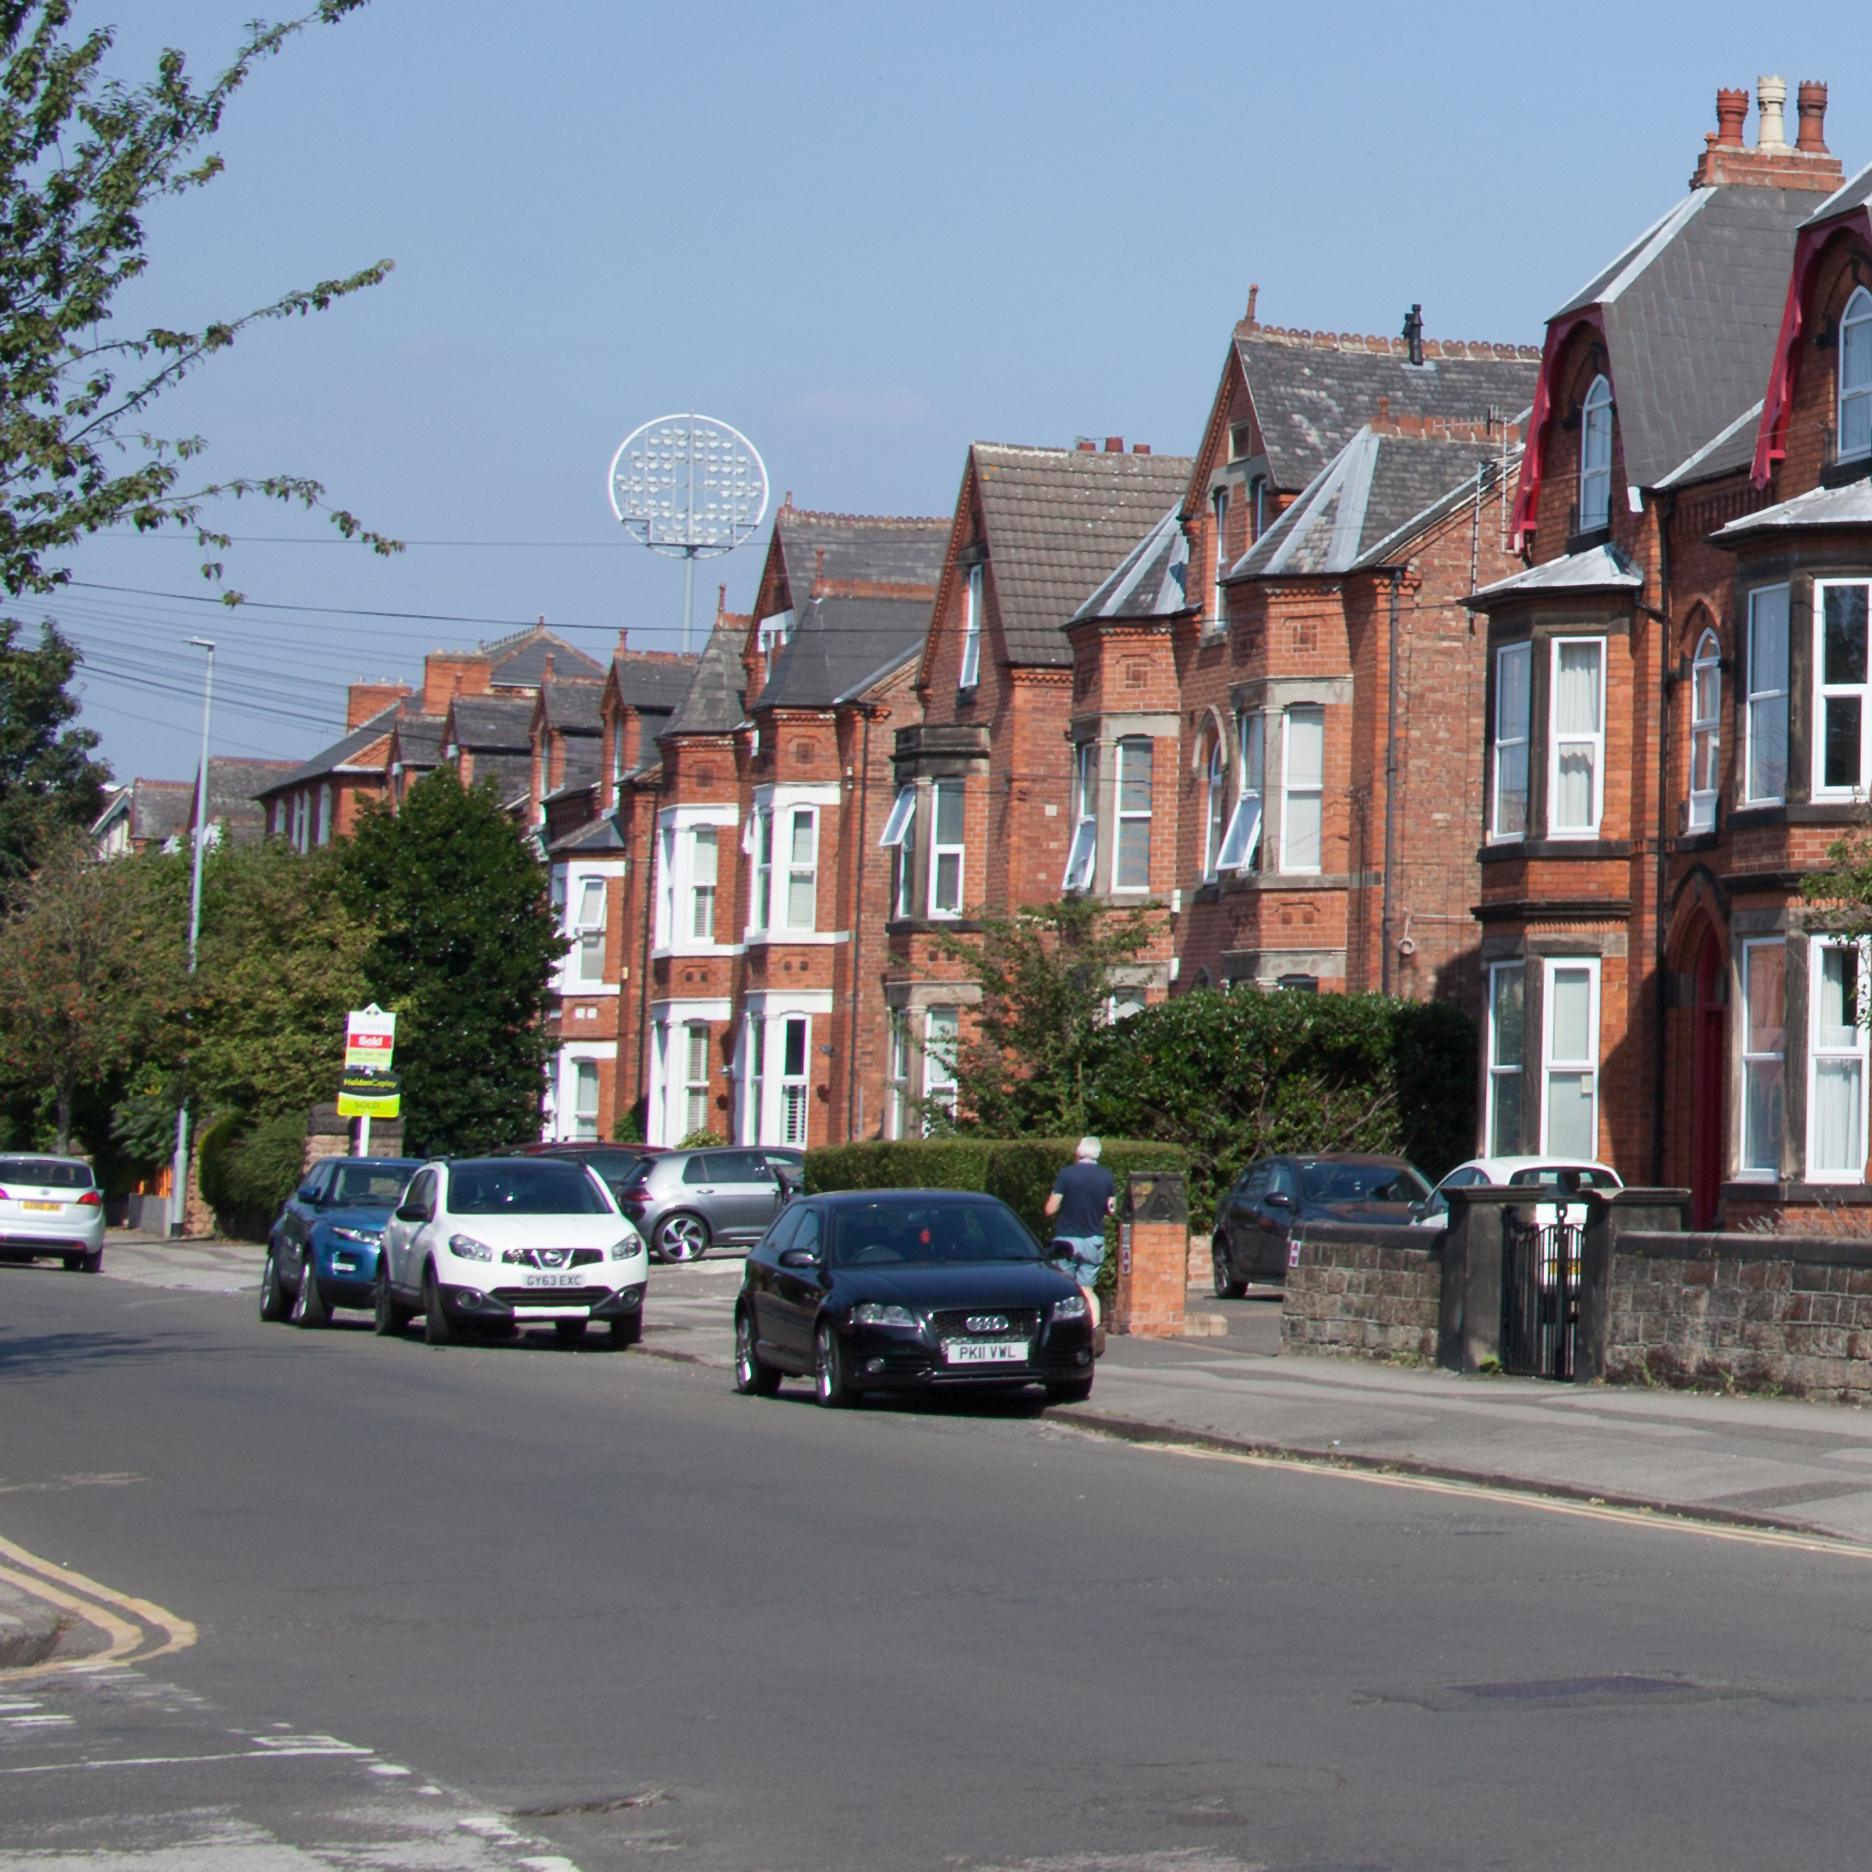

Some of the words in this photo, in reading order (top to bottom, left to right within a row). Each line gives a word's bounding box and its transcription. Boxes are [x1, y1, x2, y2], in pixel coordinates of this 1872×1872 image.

[358, 1035, 383, 1047] Sold
[526, 1275, 557, 1286] GY63
[559, 1274, 583, 1286] EXC
